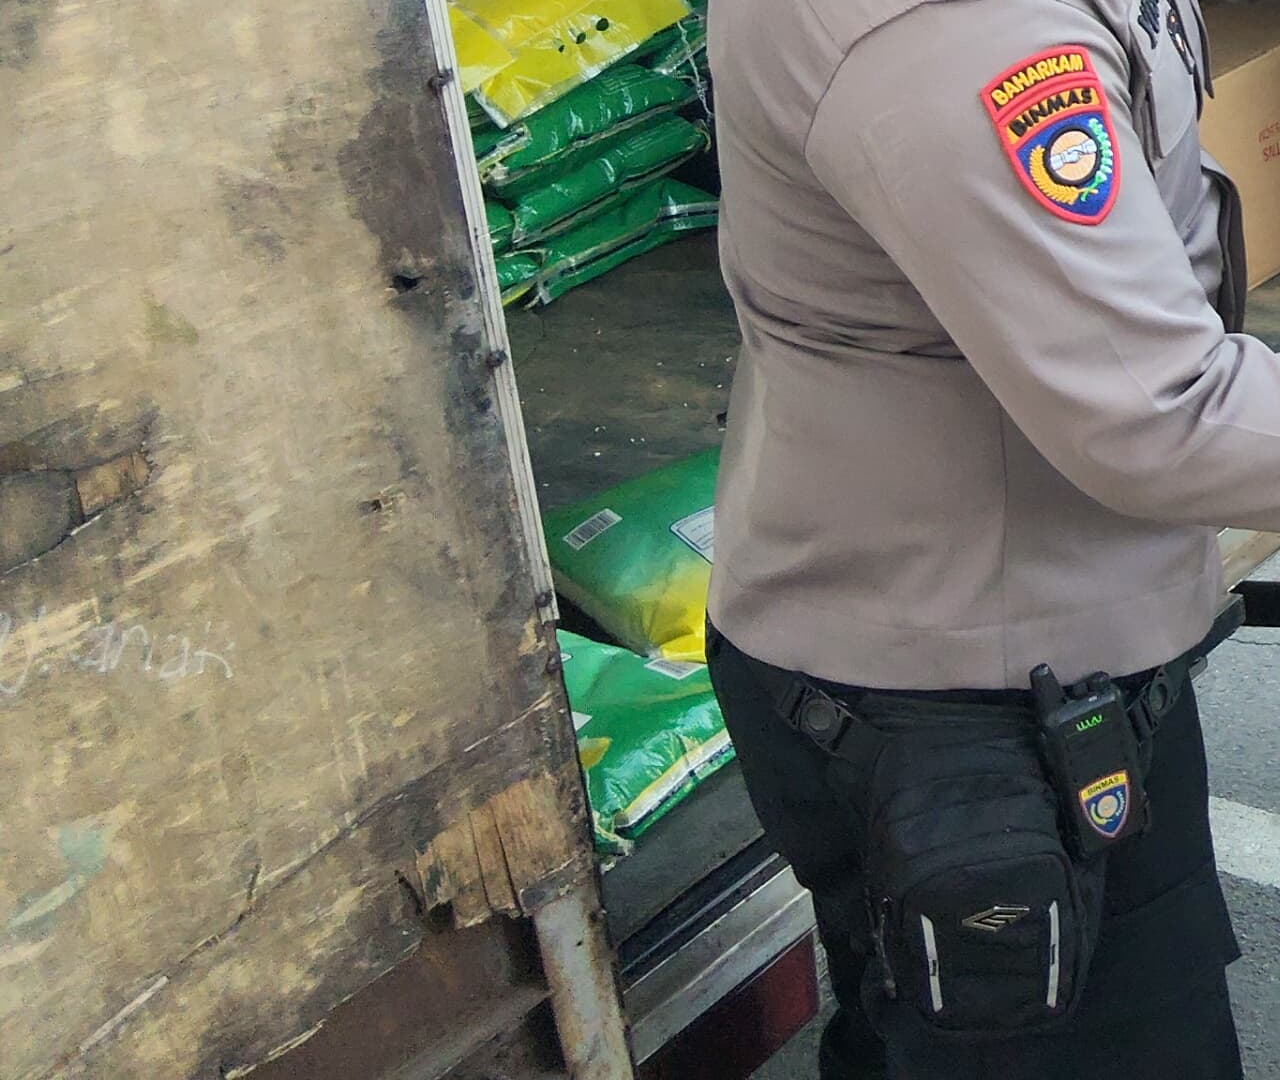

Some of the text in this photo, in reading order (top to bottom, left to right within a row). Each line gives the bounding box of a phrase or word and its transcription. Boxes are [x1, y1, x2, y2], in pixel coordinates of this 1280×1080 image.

[991, 53, 1084, 105] BAHARKAM
[1008, 88, 1093, 137] BINMAS
[1087, 776, 1120, 795] BINMAS
